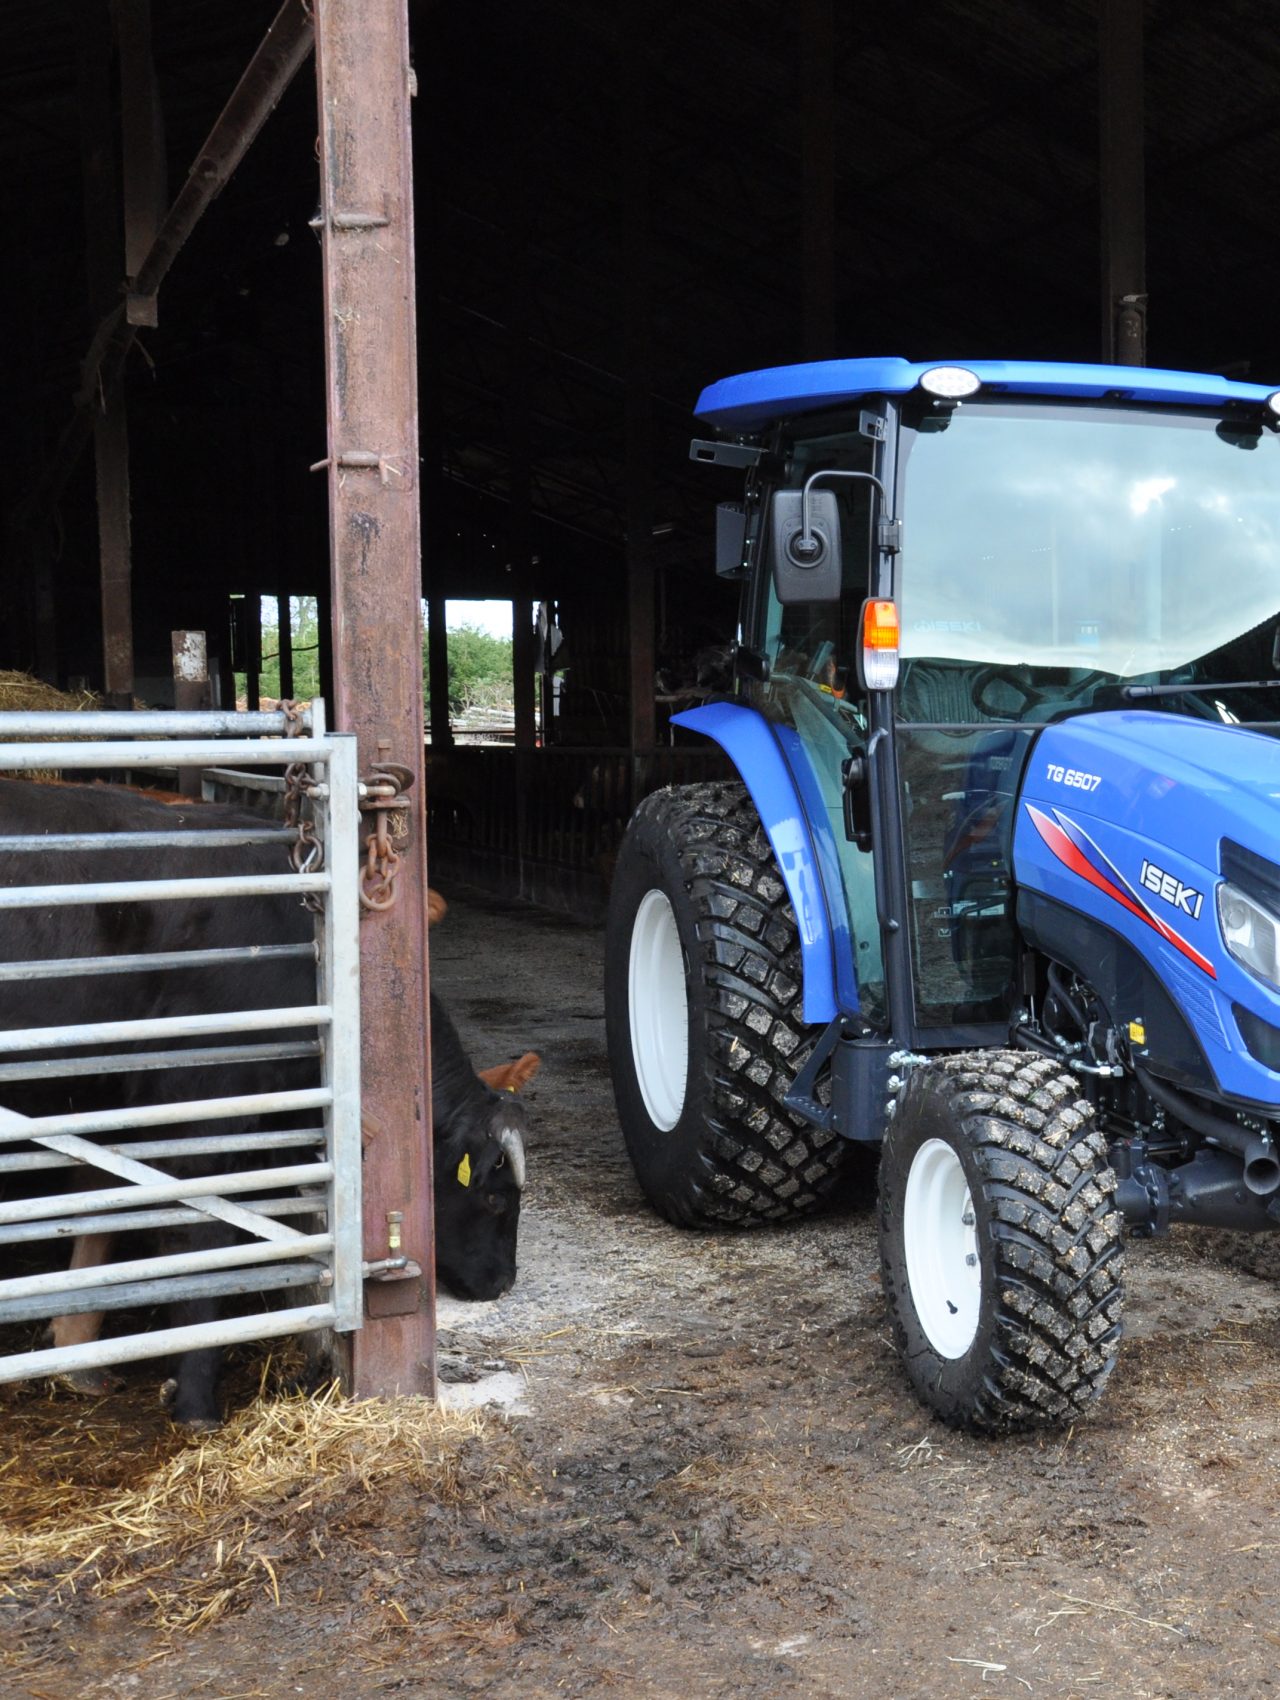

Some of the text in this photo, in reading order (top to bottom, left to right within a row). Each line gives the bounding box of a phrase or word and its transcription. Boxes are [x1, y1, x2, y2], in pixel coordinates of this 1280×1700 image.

[930, 620, 981, 633] ISEKI
[1046, 763, 1102, 792] TG 6507
[1139, 859, 1204, 920] ISEKI
